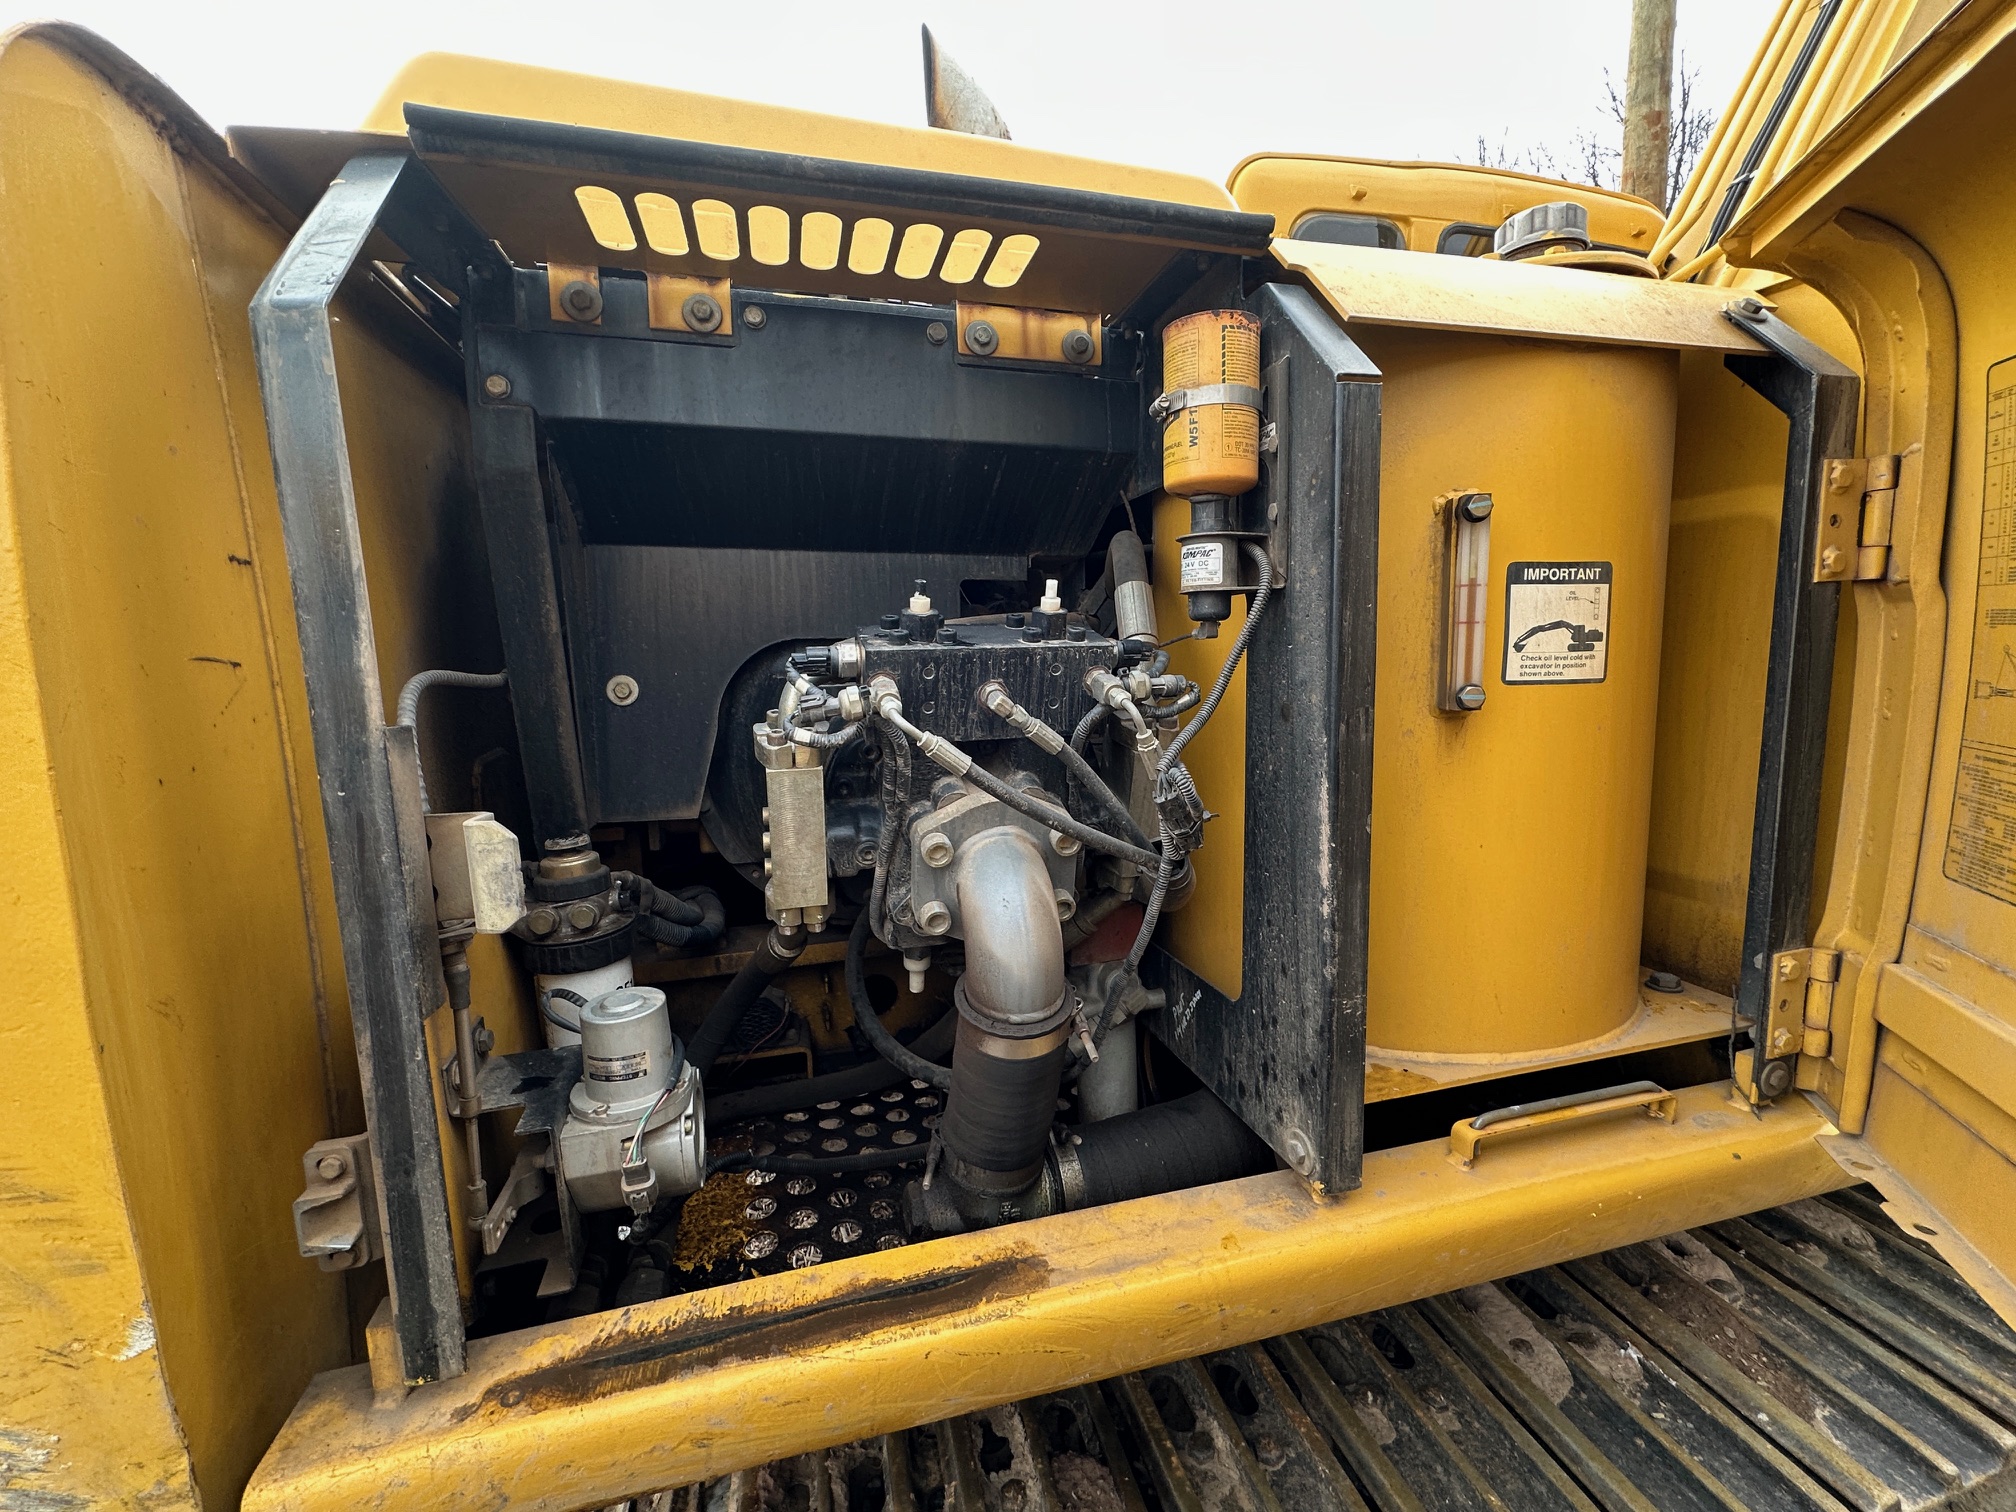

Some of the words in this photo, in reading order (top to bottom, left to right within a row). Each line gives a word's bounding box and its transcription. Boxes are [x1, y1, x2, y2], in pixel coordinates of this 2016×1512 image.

[1188, 404, 1199, 447] W5F1
[1523, 568, 1601, 580] IMPORTANT
[1562, 662, 1586, 670] position
